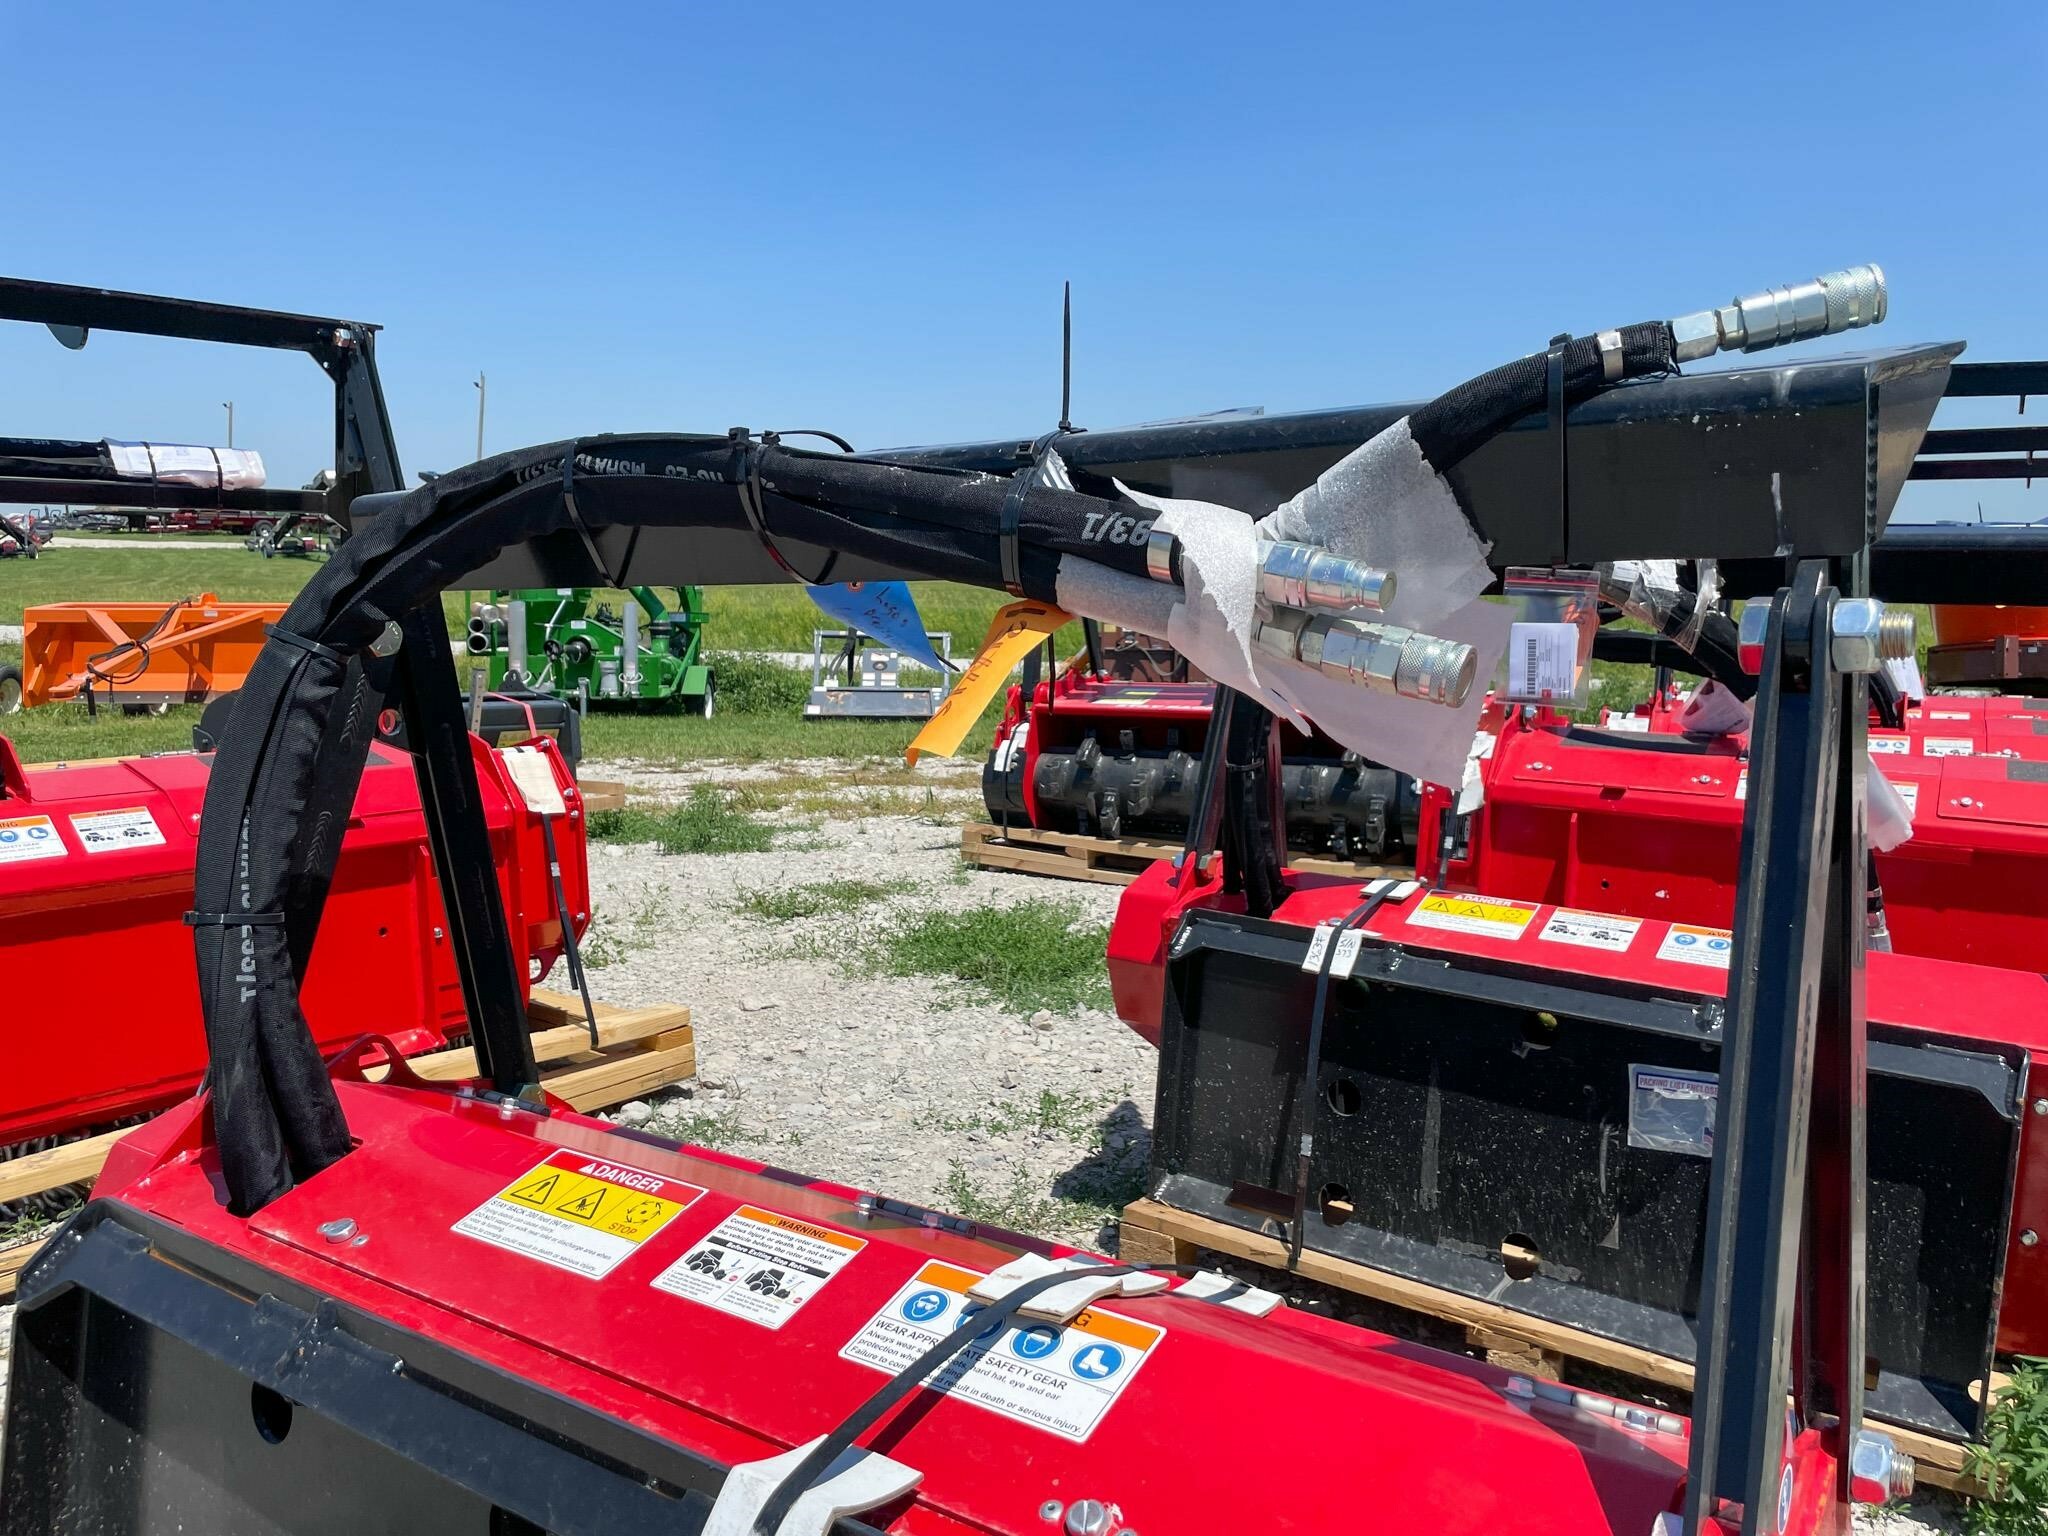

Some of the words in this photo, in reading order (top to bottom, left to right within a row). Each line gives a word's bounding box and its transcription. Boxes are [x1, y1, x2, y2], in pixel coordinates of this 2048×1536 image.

[1081, 511, 1155, 546] 93/1
[1687, 1083, 1718, 1096] ENCLOSE
[593, 1165, 663, 1191] DANGER
[608, 1222, 637, 1234] STOP
[723, 1224, 746, 1233] serious
[747, 1230, 765, 1240] injury
[774, 1239, 794, 1248] death.
[729, 1217, 755, 1228] Contact
[770, 1230, 794, 1241] moving
[825, 1248, 847, 1256] cause
[778, 1219, 827, 1238] WARNING
[725, 1241, 748, 1252] Before
[747, 1248, 772, 1261] Exiting
[771, 1256, 788, 1266] Stop
[787, 1261, 808, 1271] Rotor
[728, 1232, 751, 1242] vehicle
[751, 1239, 773, 1249] before
[785, 1250, 803, 1258] rotor
[803, 1256, 822, 1265] stops.
[857, 1338, 898, 1355] protection
[898, 1351, 919, 1362] whe
[866, 1329, 894, 1343] Always
[895, 1340, 915, 1350] wear
[944, 1357, 969, 1369] oots,
[990, 1371, 1006, 1383] hat,
[1008, 1379, 1025, 1388] eye
[1025, 1385, 1045, 1395] and
[1044, 1392, 1060, 1400] ear
[875, 1319, 908, 1335] WEAR
[906, 1330, 986, 1362] APPRATE
[985, 1356, 1031, 1376] SAFETY
[1032, 1373, 1067, 1389] GEAR
[850, 1345, 878, 1359] Failure
[877, 1355, 888, 1363] to
[886, 1359, 908, 1370] com
[924, 1371, 945, 1383] ould
[943, 1378, 969, 1391] result
[969, 1387, 979, 1395] in
[979, 1392, 1005, 1405] death
[1017, 1406, 1051, 1421] serious
[1052, 1418, 1080, 1432] injury.
